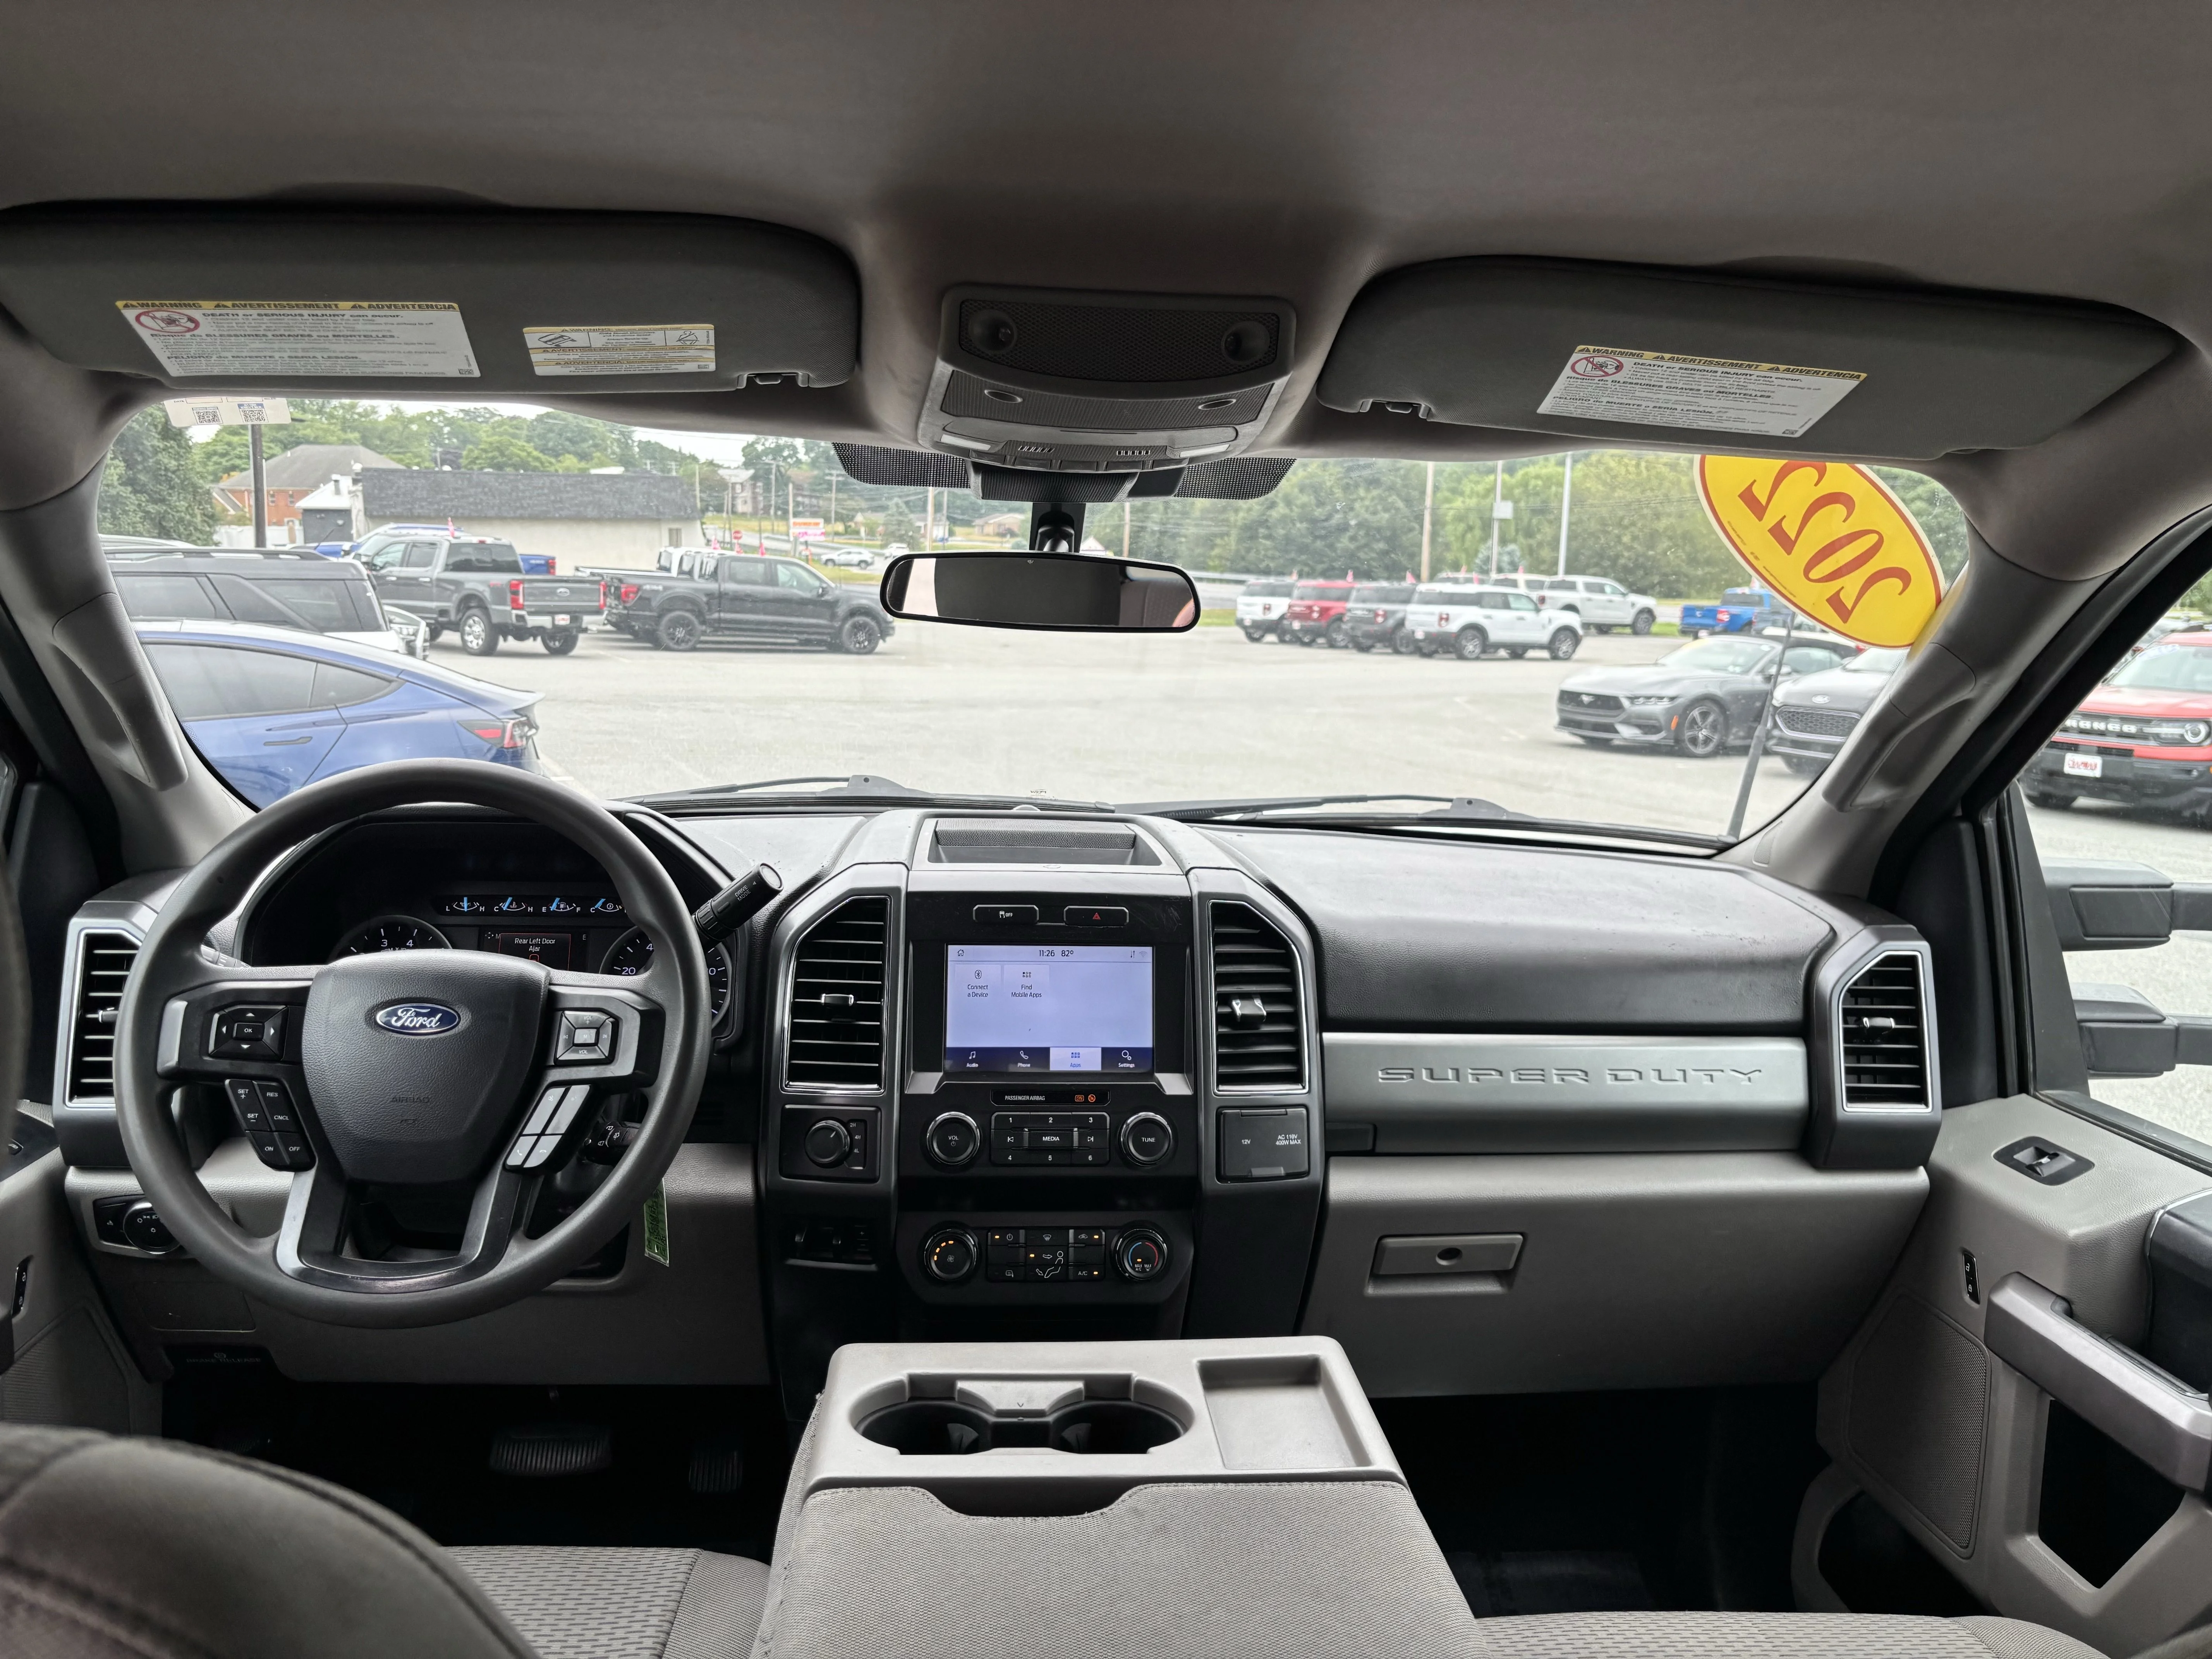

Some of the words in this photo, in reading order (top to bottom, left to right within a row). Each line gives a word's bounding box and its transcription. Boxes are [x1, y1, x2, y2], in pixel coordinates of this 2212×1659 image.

[1592, 348, 1645, 358] WARNING
[1666, 356, 1762, 369] AVERTISSEMENT
[1782, 367, 1861, 380] ADVERTENCIA
[392, 1008, 443, 1027] Ford
[1378, 1068, 1589, 1084] SUPER
[1606, 1068, 1762, 1085] DUTY
